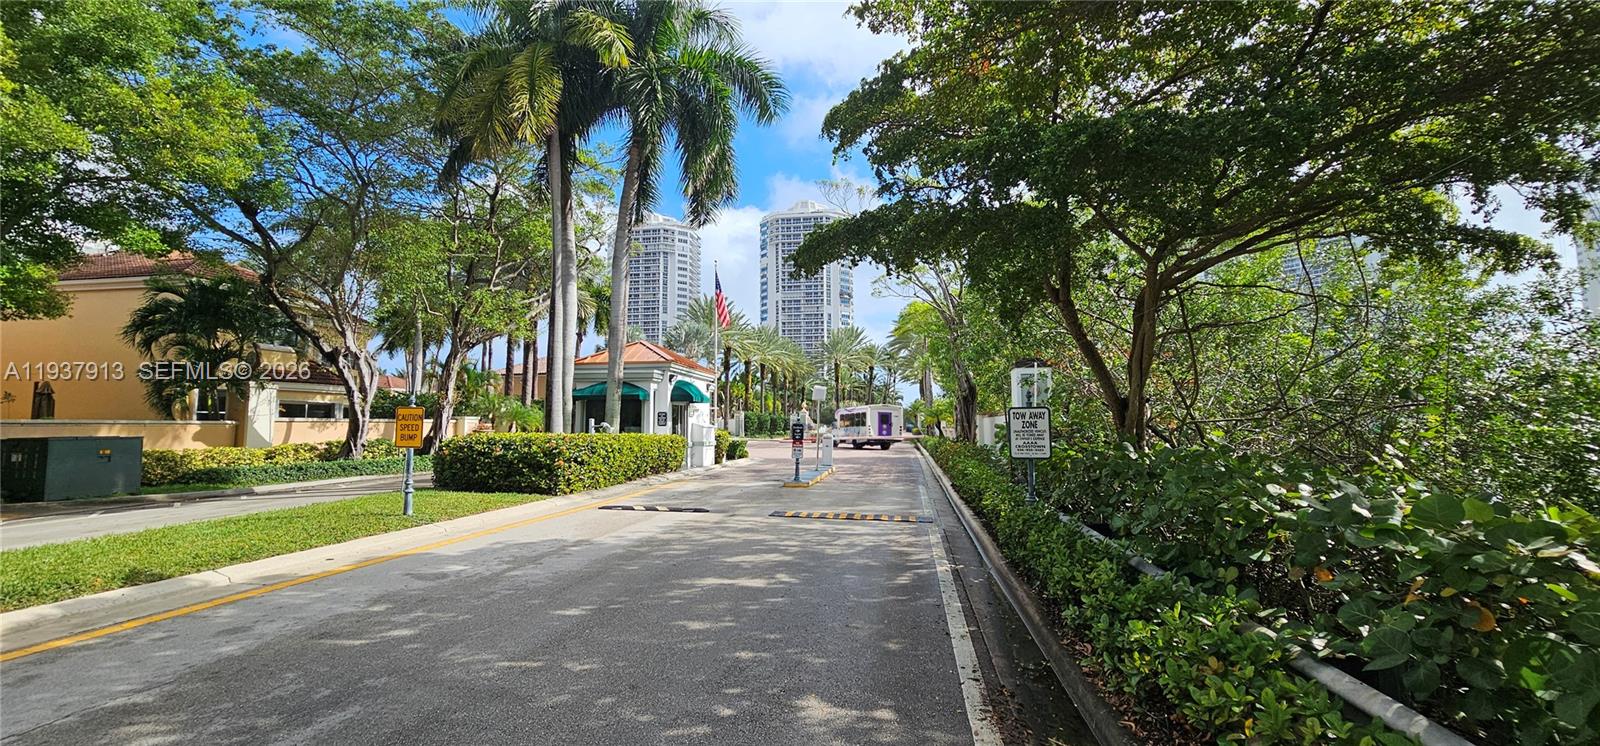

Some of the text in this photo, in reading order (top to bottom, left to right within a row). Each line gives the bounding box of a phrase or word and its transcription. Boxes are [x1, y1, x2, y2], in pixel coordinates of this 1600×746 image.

[1013, 412, 1046, 420] TOW AWAY
[1021, 421, 1038, 429] ZONE
